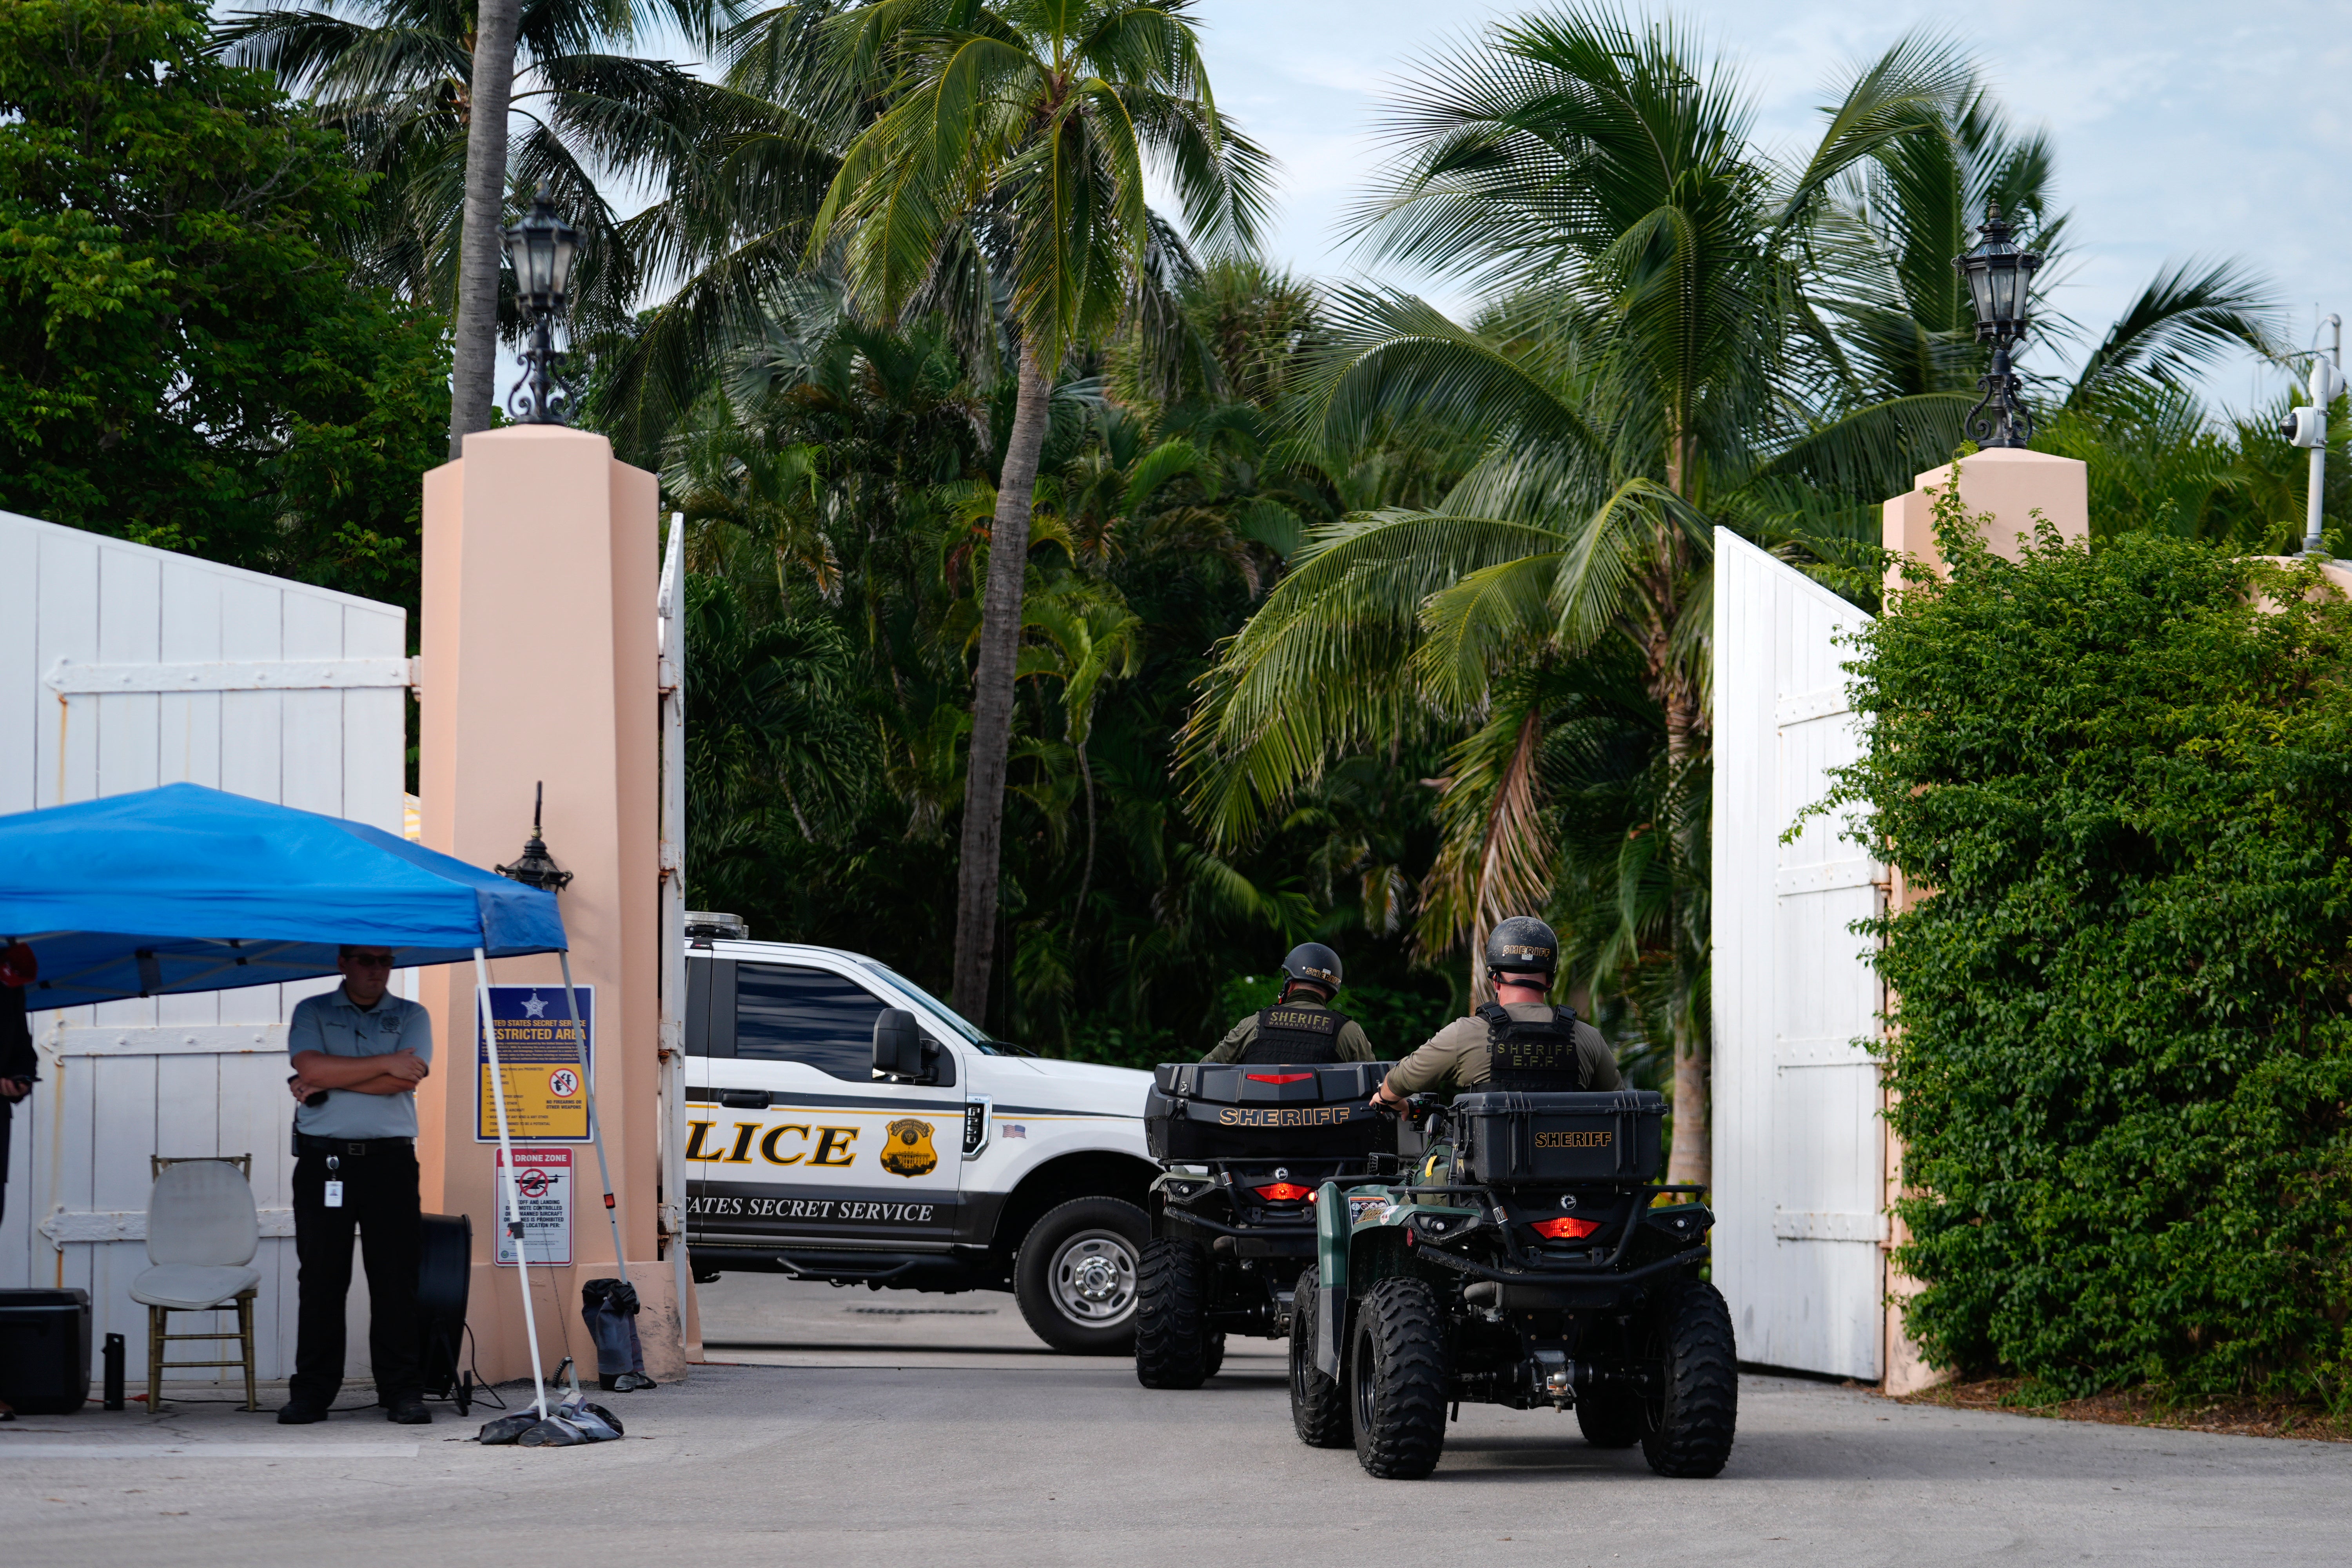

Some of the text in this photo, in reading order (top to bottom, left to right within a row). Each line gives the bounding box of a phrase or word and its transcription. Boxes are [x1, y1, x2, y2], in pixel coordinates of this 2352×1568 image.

[1503, 945, 1550, 957] SHERIFF
[1270, 1012, 1331, 1026] SHERIFF
[1497, 1043, 1573, 1055] SHERIFF
[1513, 1055, 1558, 1067] E.F.F.
[1220, 1107, 1350, 1126] SHERIFF
[1535, 1132, 1611, 1147] SHERIFF
[748, 1198, 835, 1218] SECRET
[838, 1201, 933, 1221] SERVICE
